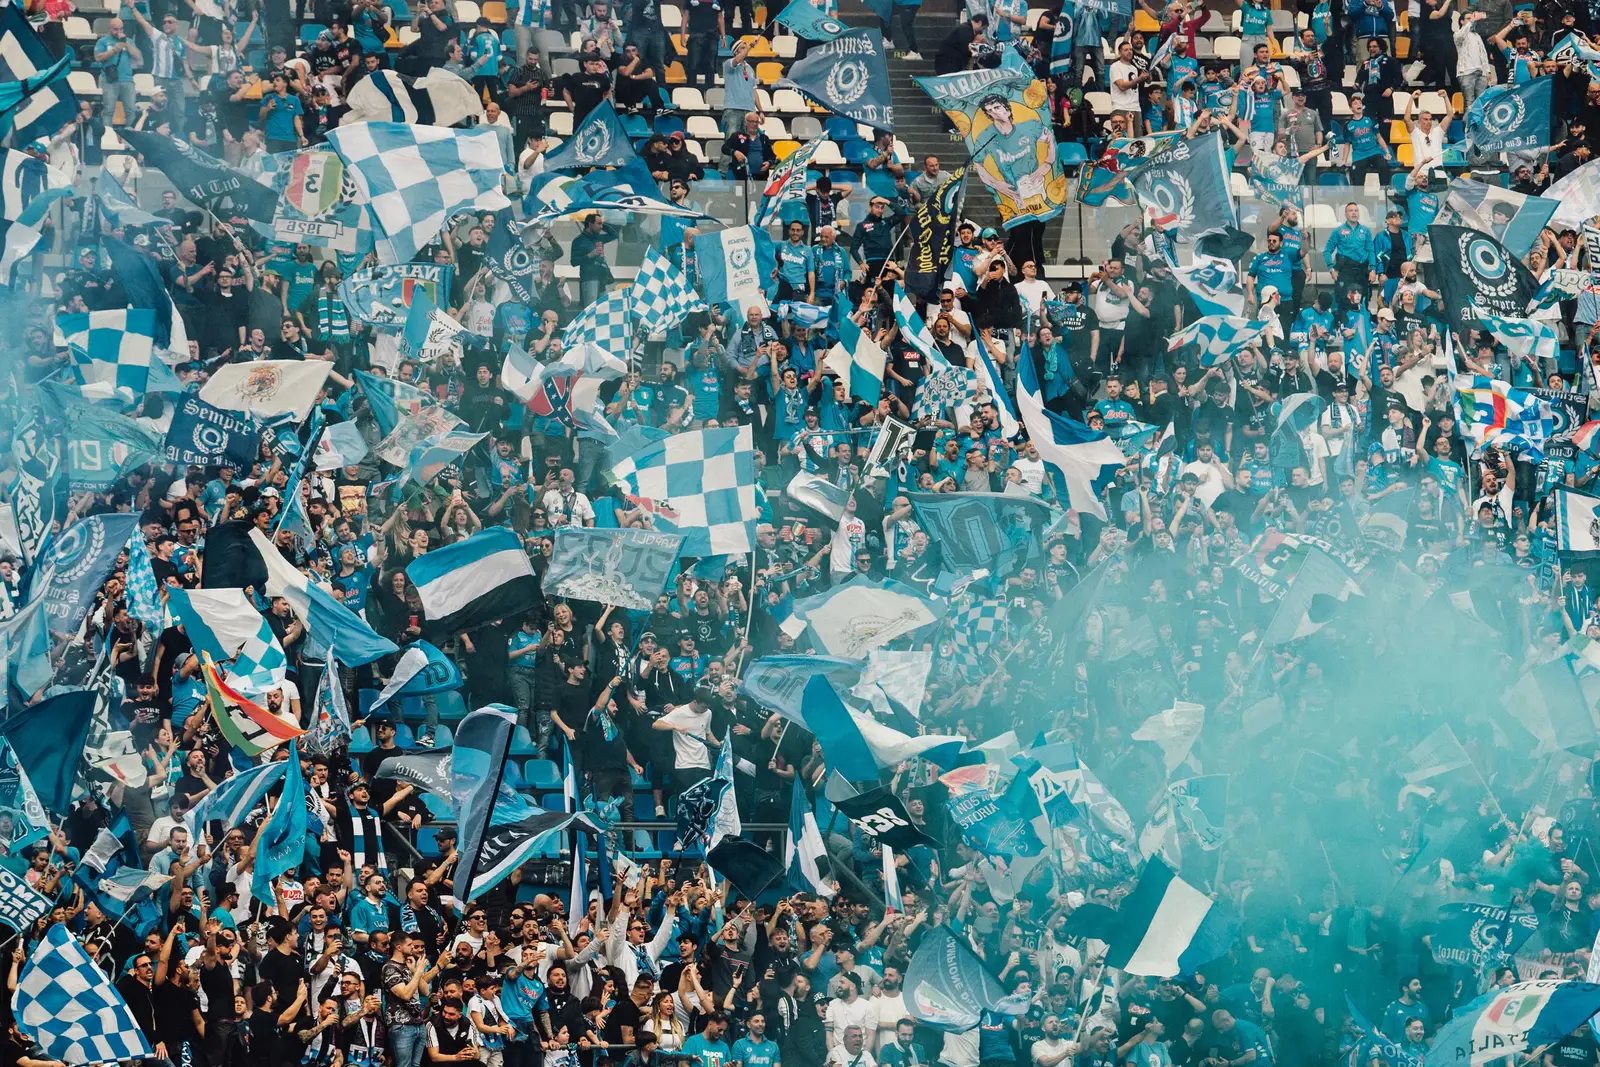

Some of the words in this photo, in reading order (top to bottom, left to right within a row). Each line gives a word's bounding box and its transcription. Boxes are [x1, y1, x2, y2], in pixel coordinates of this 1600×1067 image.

[184, 399, 251, 436] Sempre
[166, 446, 179, 462] Al
[183, 450, 208, 464] Tuo
